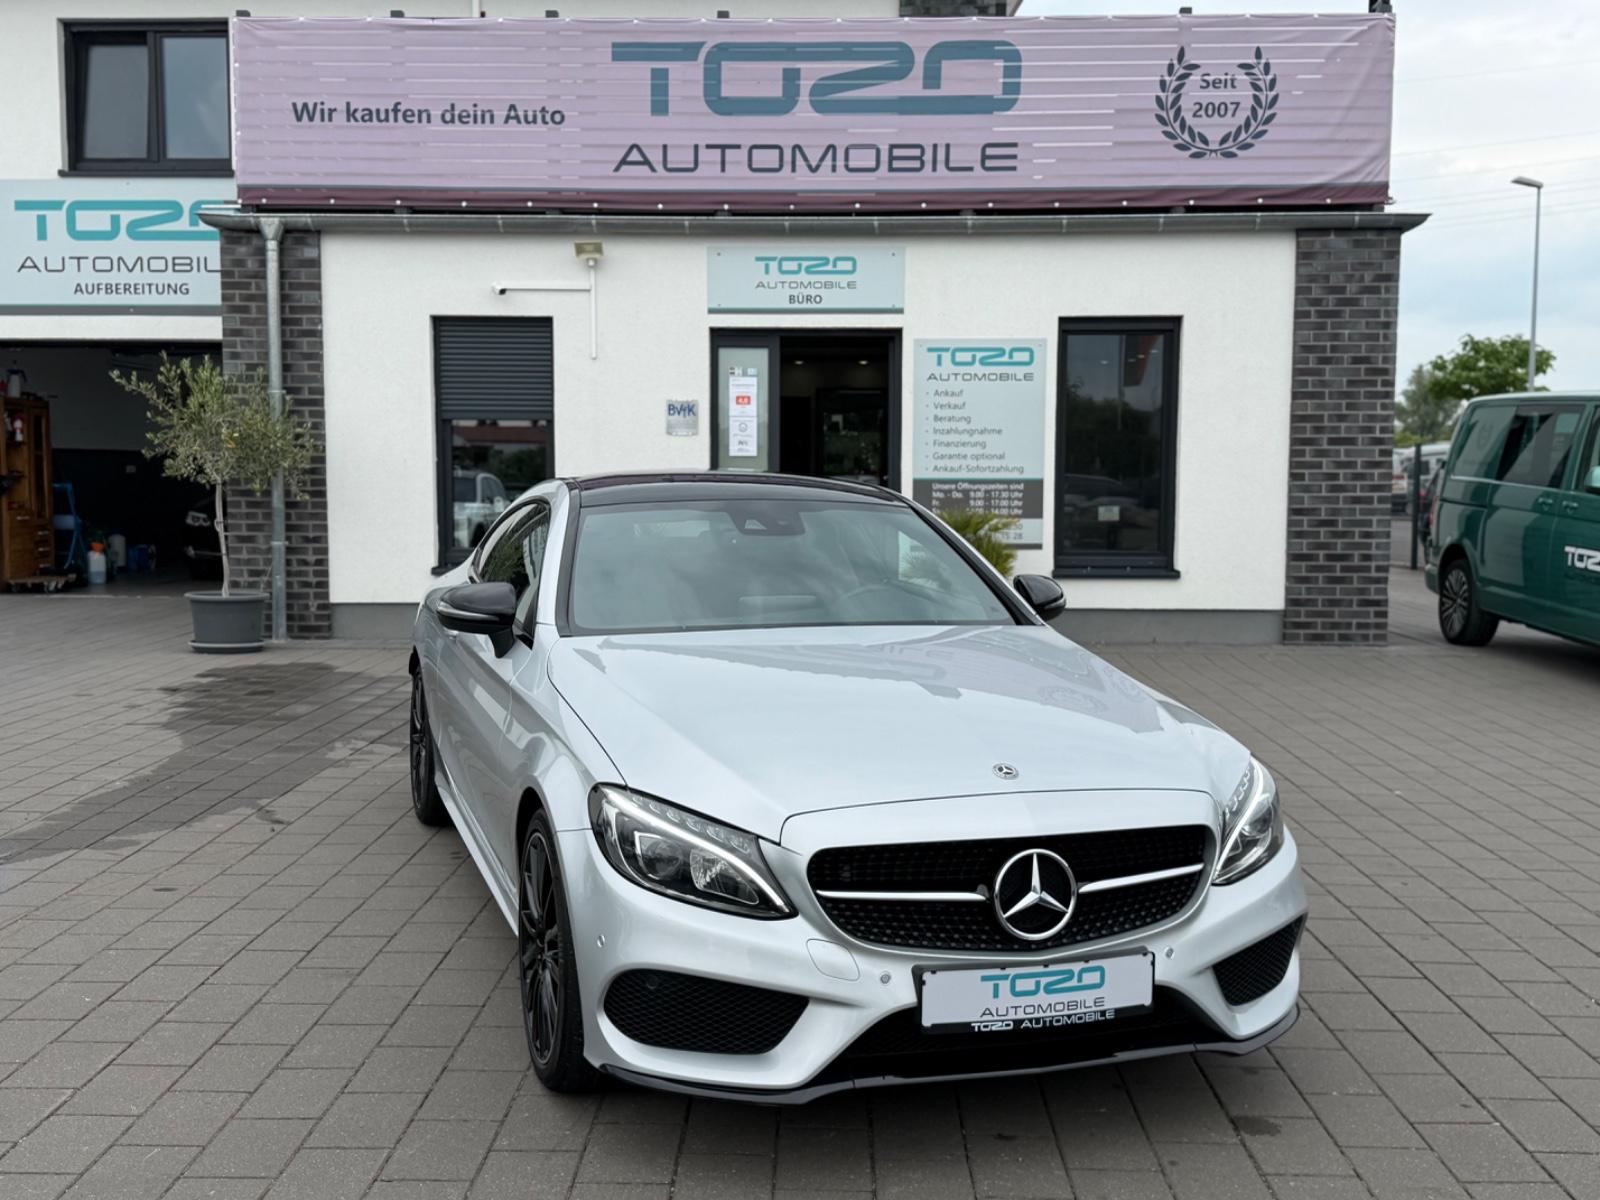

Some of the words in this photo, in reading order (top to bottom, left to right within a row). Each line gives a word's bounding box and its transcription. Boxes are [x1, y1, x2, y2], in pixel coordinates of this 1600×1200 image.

[611, 40, 1022, 116] TOZO
[1200, 72, 1237, 89] Seit
[292, 101, 337, 123] Wir
[345, 101, 432, 124] kaufen
[440, 103, 495, 125] dein
[503, 104, 566, 125] Auto
[1192, 101, 1241, 118] 2007
[613, 142, 1018, 173] AUTOMOBILE
[17, 256, 222, 273] AUTOMOBIL
[755, 256, 857, 275] TOZO
[74, 282, 190, 295] AUFBEREITUNG
[755, 281, 857, 290] AUTOMOBILE
[788, 292, 823, 305] BÜRO
[927, 347, 1034, 366] TOZO
[927, 373, 1034, 381] AUTOMOBILE
[933, 389, 964, 398] Ankauf
[933, 401, 966, 410] Verkauf
[933, 414, 971, 424] Beratung
[932, 427, 1003, 437] Inzahlungnahme
[932, 440, 987, 450] Finanzierung
[932, 452, 968, 461] Garantie
[970, 452, 1005, 462] optional
[932, 464, 1024, 475] Ankauf-Sofortzahlung
[1564, 545, 1600, 572] TOZ
[980, 965, 1106, 999] TOZO
[980, 997, 1106, 1018] AUTOMOBILE
[971, 1021, 1013, 1031] TOZO
[1021, 1009, 1114, 1028] AUTOMOBILE
